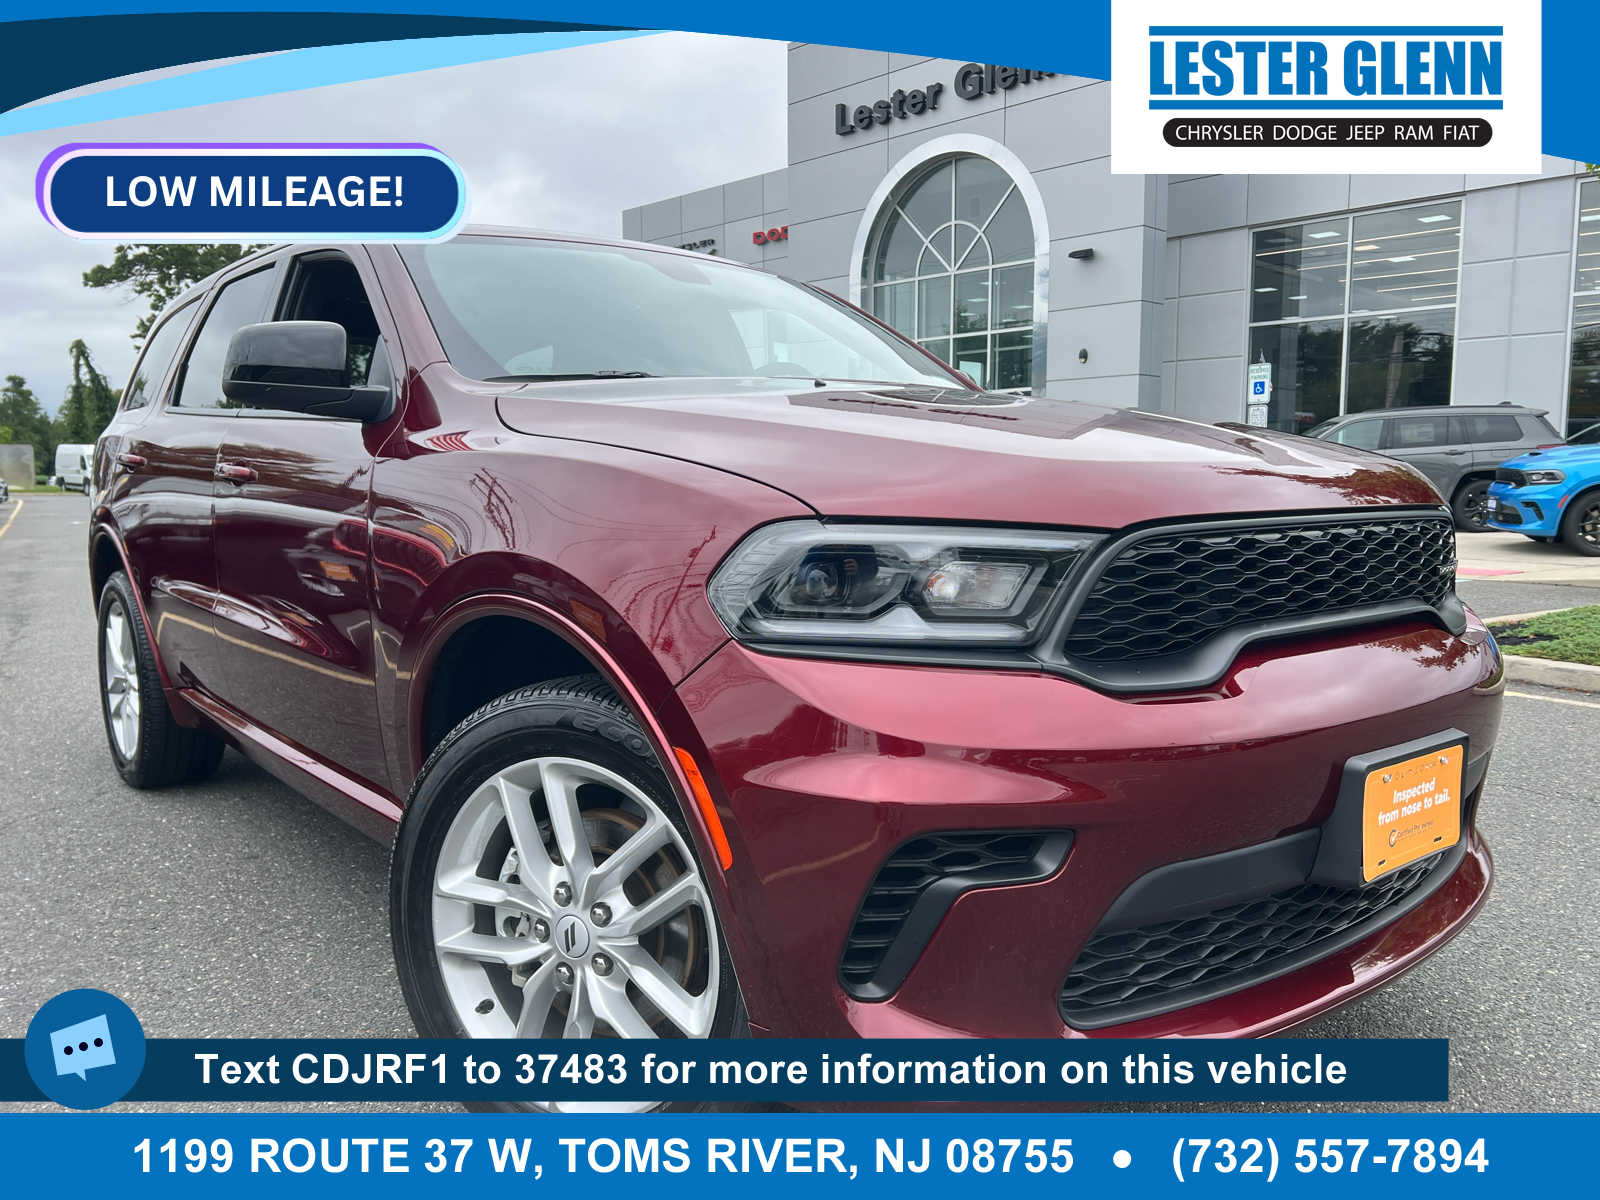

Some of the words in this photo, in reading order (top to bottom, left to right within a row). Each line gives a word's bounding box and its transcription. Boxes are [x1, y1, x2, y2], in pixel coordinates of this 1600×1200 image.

[835, 82, 944, 136] Lester
[1378, 810, 1399, 826] from
[1401, 801, 1422, 817] nose
[1423, 797, 1433, 809] to
[1434, 788, 1450, 805] tail.
[1393, 776, 1436, 803] Inspected
